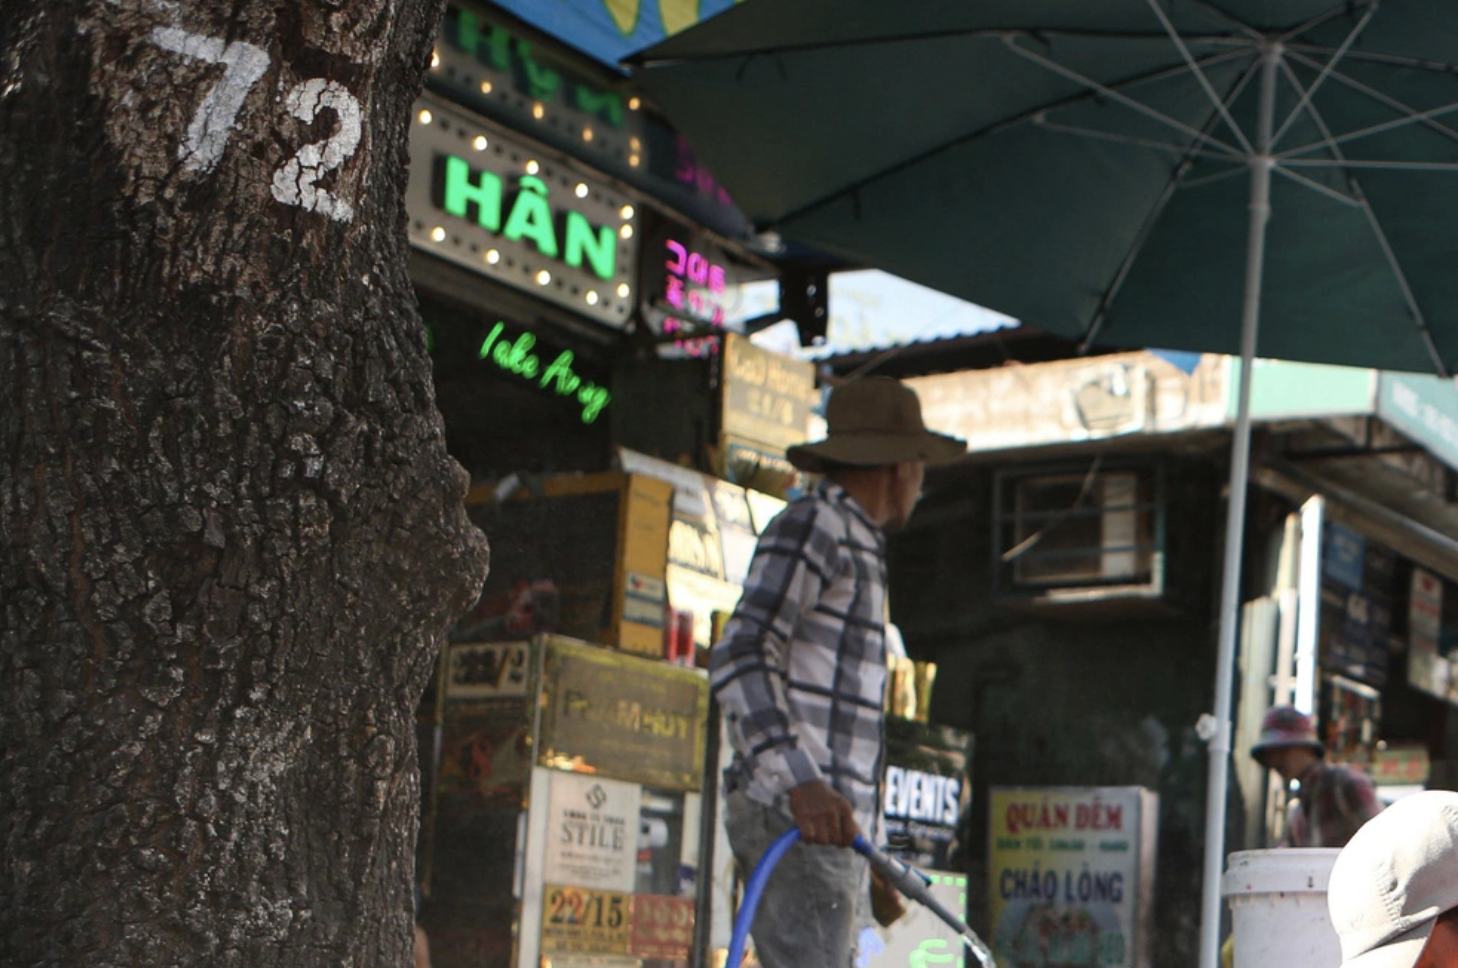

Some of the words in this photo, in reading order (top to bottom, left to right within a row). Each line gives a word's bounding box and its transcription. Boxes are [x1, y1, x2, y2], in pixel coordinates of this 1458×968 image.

[444, 153, 617, 281] HÂN
[884, 764, 960, 826] EVENTS
[560, 819, 625, 852] STILE
[549, 886, 624, 928] 22/15
